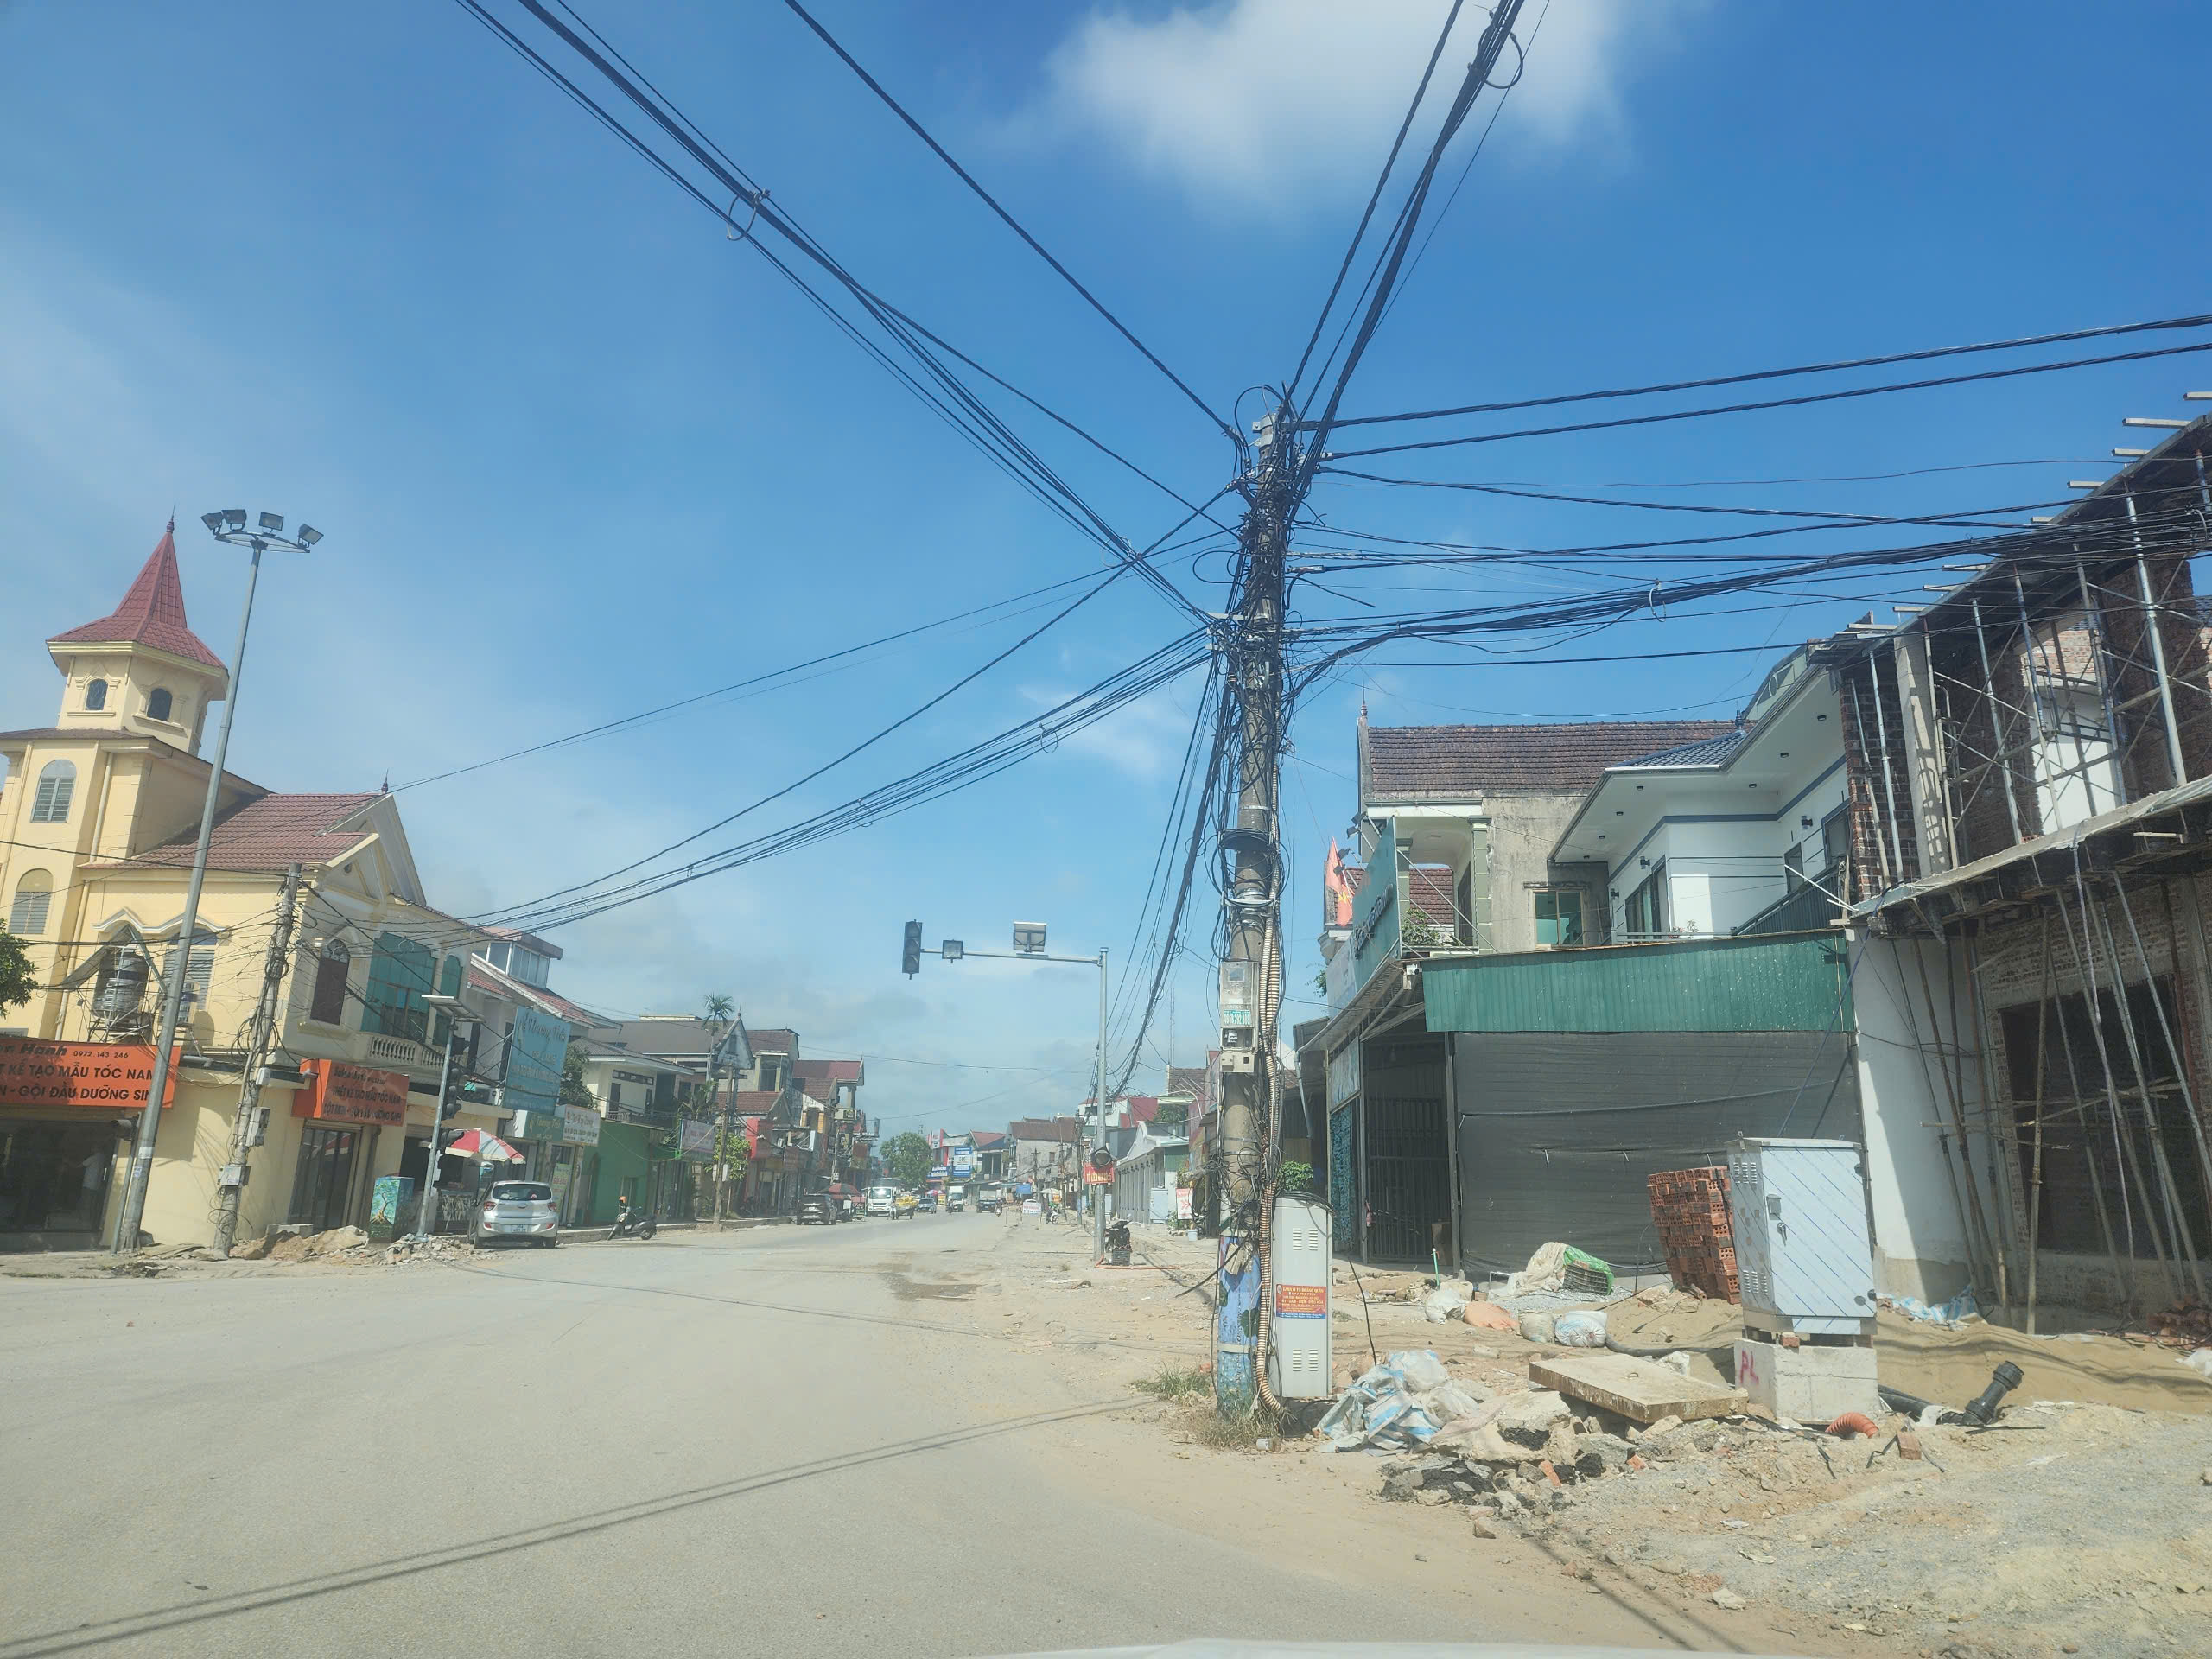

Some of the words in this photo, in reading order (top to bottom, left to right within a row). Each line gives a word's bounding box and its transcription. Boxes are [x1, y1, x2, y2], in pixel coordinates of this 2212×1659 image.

[29, 1065, 55, 1078] TẠO
[58, 1061, 89, 1077] MẪU
[94, 1064, 122, 1078] TÓC
[18, 1083, 45, 1099] GỘI
[49, 1081, 77, 1099] ĐẦU
[80, 1084, 130, 1100] DƯỠNG
[1740, 1350, 1760, 1383] PL
